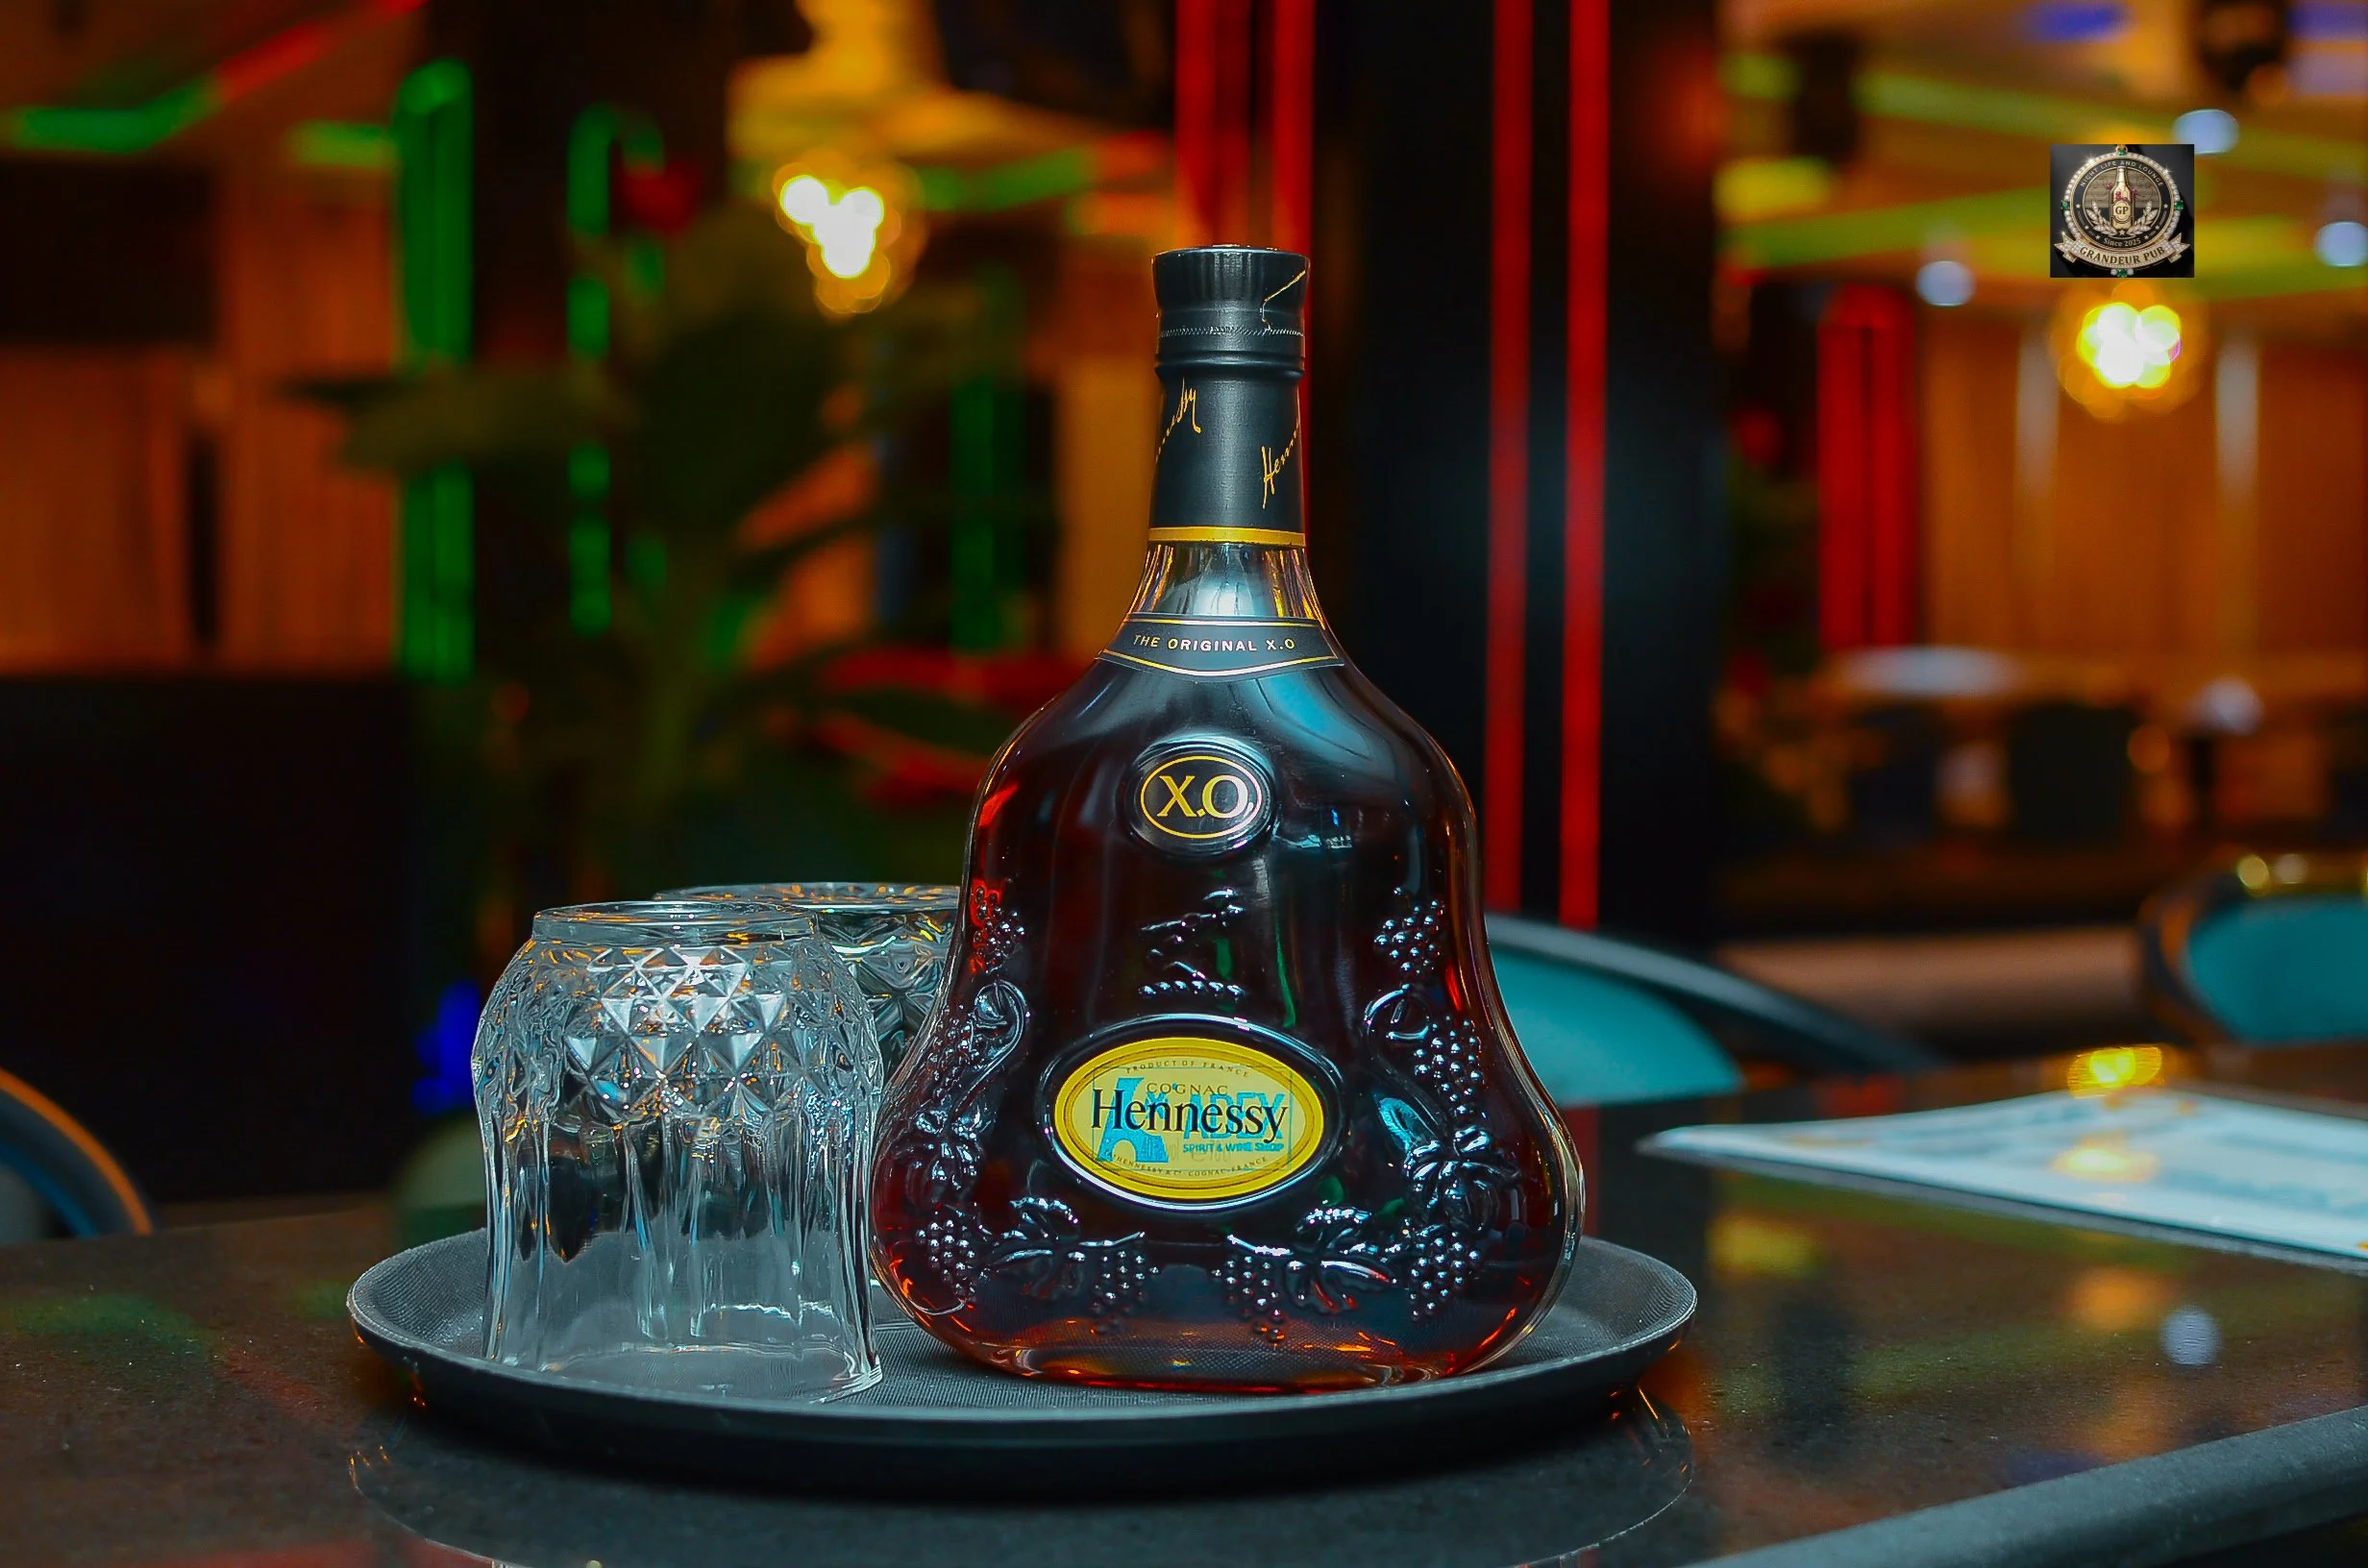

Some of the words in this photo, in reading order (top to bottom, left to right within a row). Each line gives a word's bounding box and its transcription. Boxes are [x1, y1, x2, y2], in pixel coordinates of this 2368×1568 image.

[1133, 634, 1161, 648] THE
[1168, 638, 1257, 651] ORIGINAL
[1126, 1060, 1176, 1074] PRODUCT
[1202, 1061, 1248, 1077] FRANCE
[1147, 1082, 1228, 1095] COGNAC
[1091, 1089, 1288, 1143] Hennessy
[1183, 1142, 1215, 1153] SPIRIT
[1216, 1142, 1222, 1152] &
[1225, 1141, 1252, 1152] WINE
[1254, 1141, 1284, 1152] SHOP
[1117, 1156, 1163, 1173] HENNESSY
